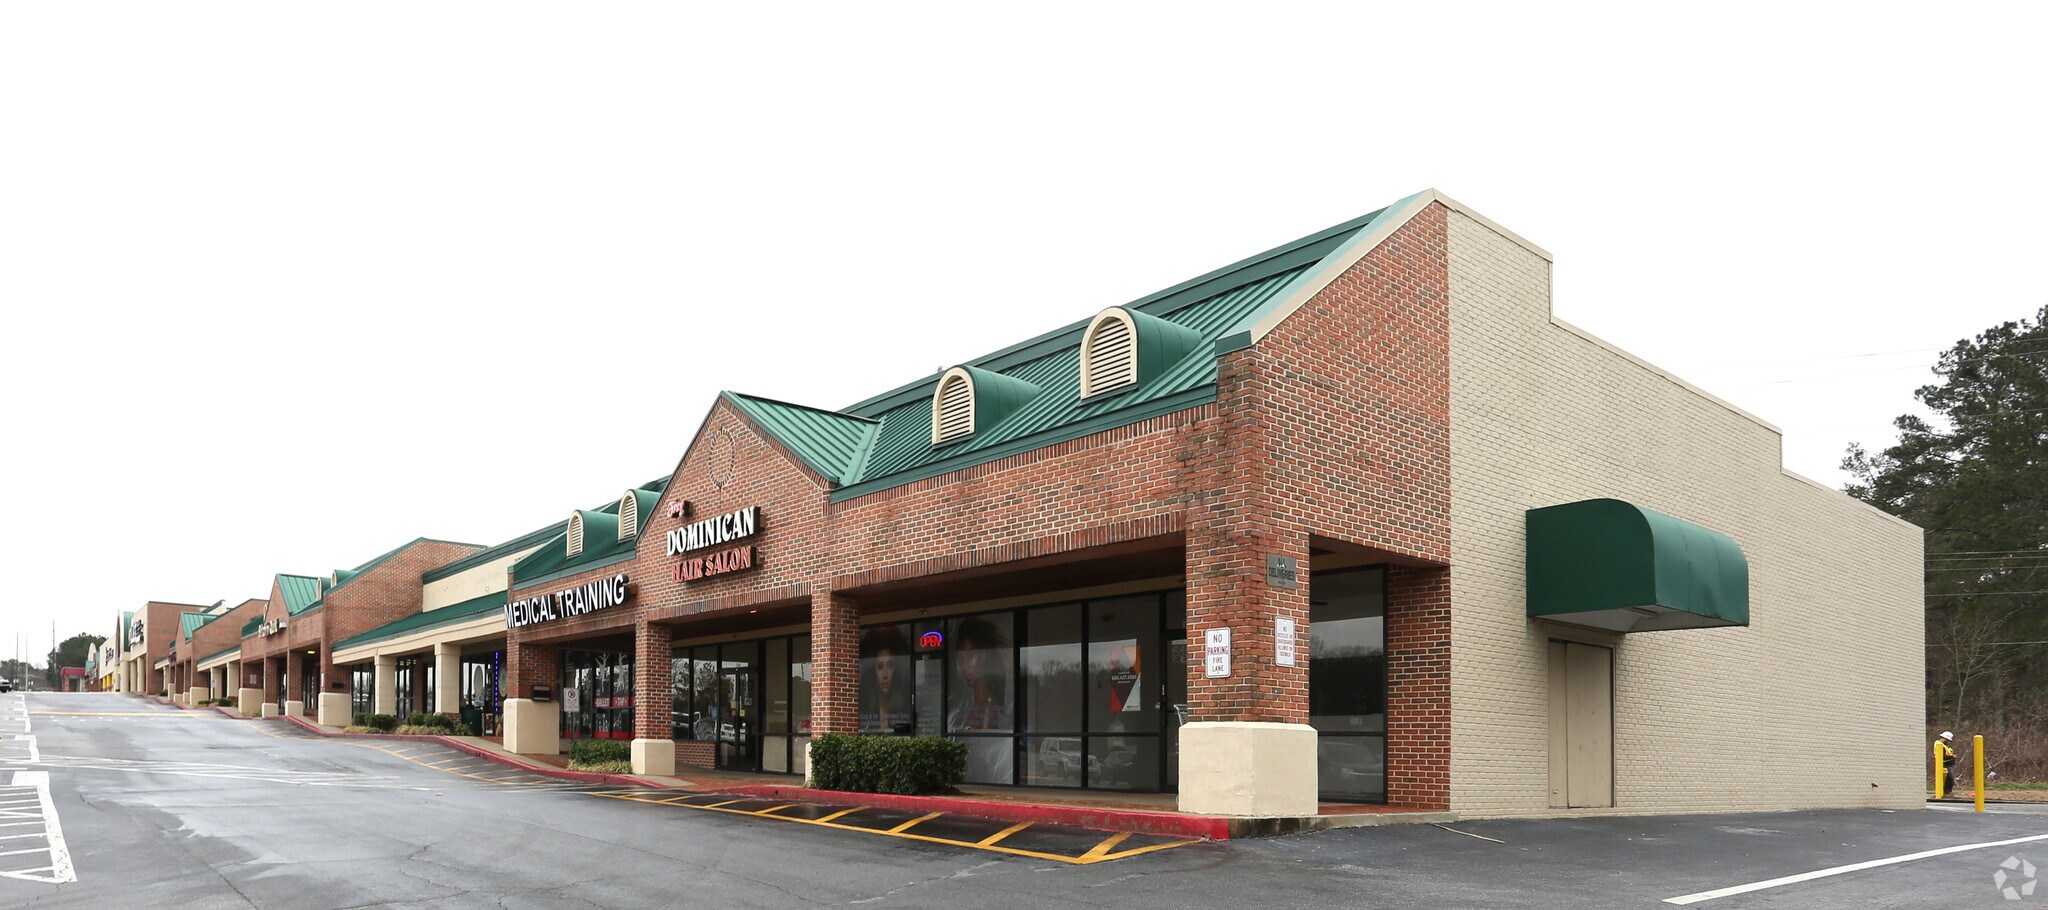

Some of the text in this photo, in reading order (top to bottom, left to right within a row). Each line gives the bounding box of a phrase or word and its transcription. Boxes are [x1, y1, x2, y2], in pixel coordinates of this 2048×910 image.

[667, 506, 755, 556] DOMINICAN
[672, 546, 751, 583] HAIR SALON
[1268, 566, 1295, 581] DELIVERIES
[504, 573, 625, 628] MEDICAL TRAINING
[920, 635, 942, 648] OPEN
[1213, 633, 1223, 643] NO
[1207, 645, 1229, 656] PARKING
